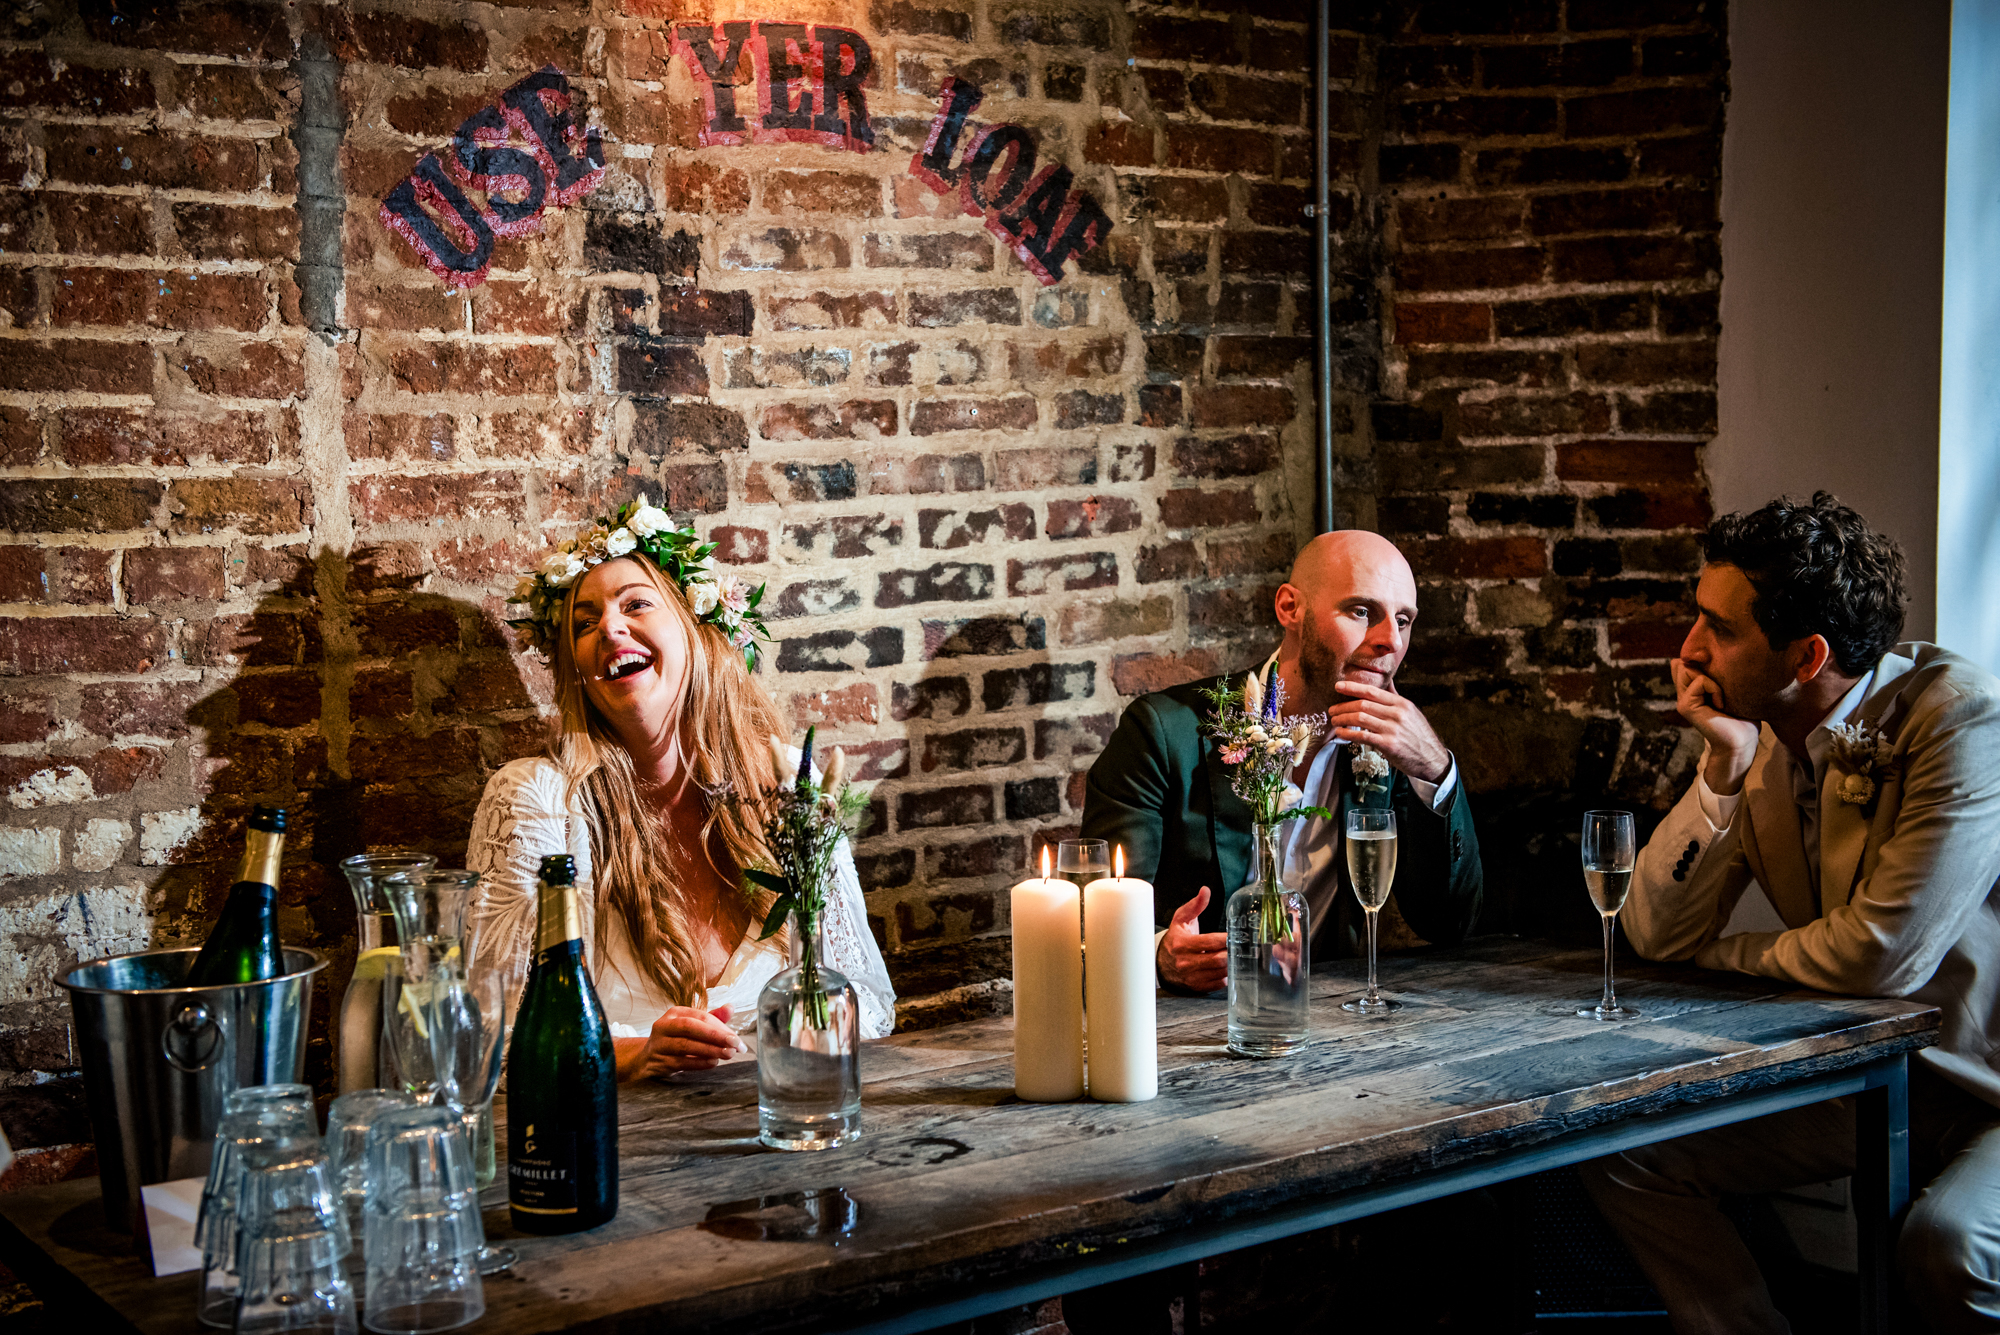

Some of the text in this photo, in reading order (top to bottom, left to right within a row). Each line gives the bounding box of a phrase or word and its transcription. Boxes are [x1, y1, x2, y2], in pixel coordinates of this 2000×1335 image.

[380, 20, 1114, 288] USE YER LOAF
